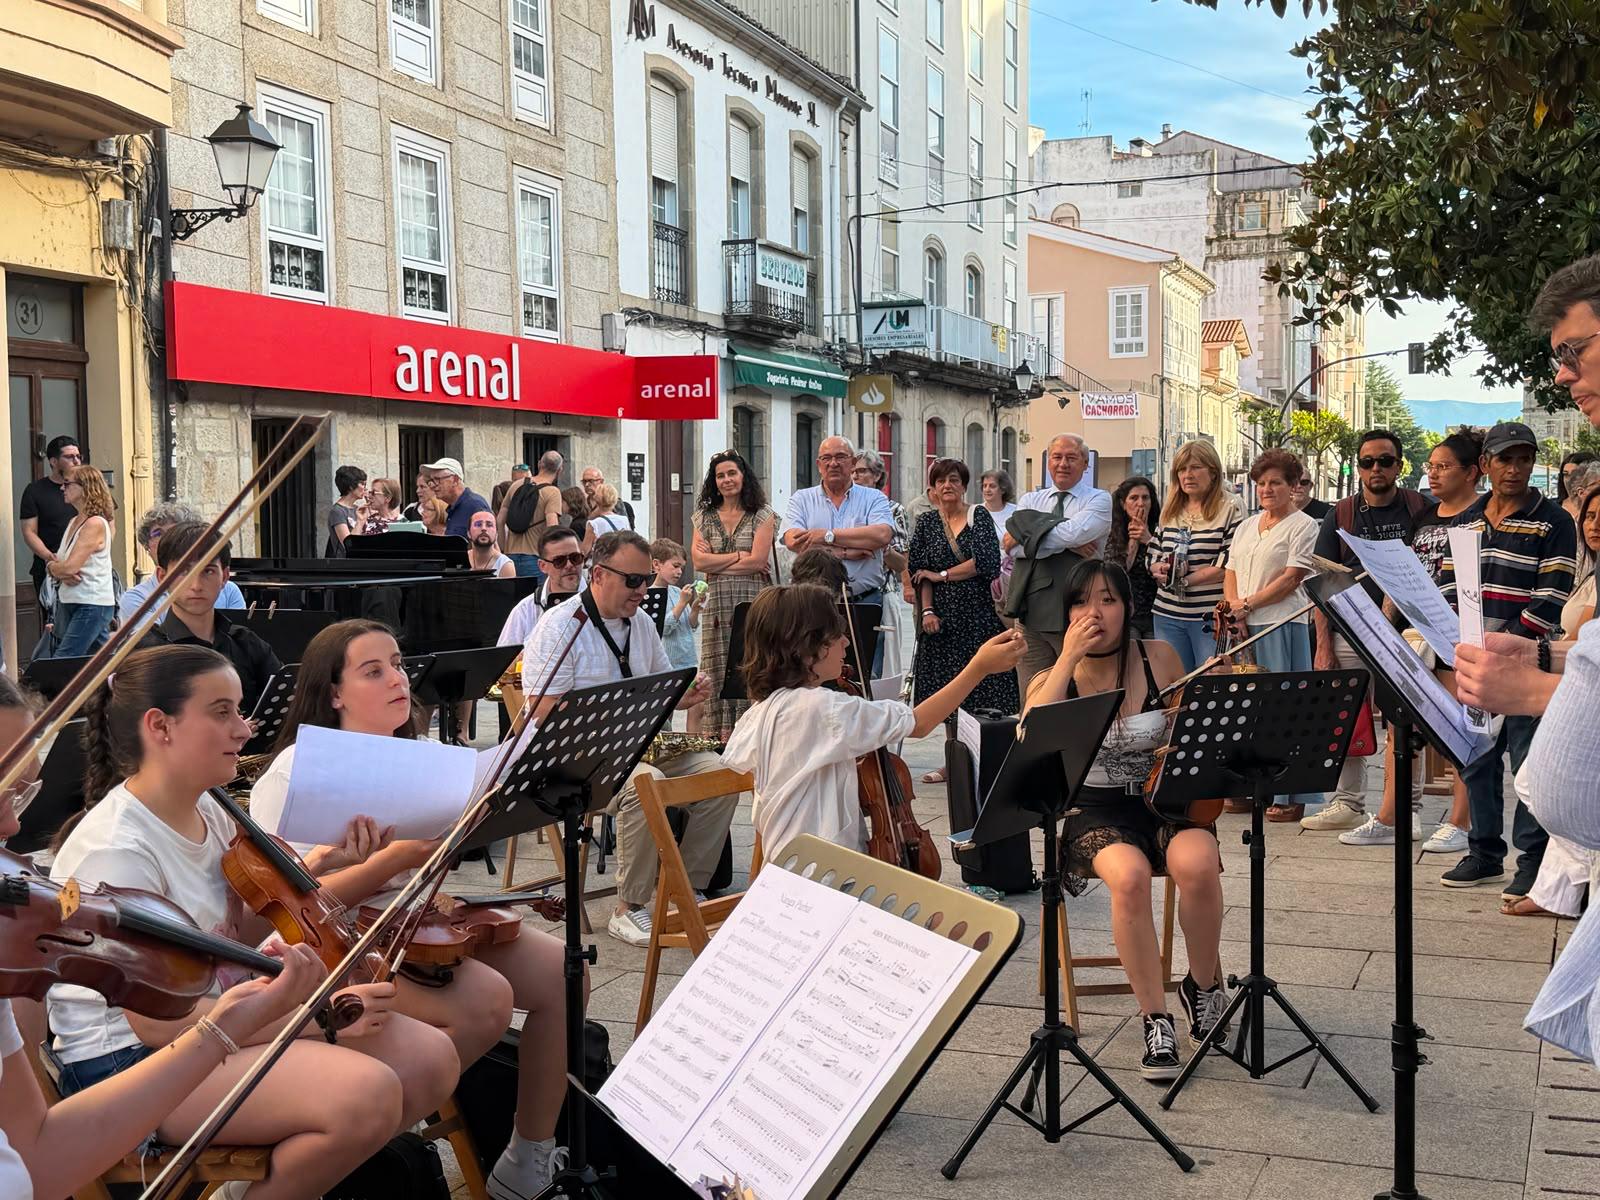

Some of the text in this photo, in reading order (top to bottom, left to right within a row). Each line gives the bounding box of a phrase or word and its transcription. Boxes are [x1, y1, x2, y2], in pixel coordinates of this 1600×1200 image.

[761, 254, 805, 288] SEGUROS
[20, 302, 38, 325] 31
[396, 343, 520, 401] arenal
[641, 377, 710, 399] arenal
